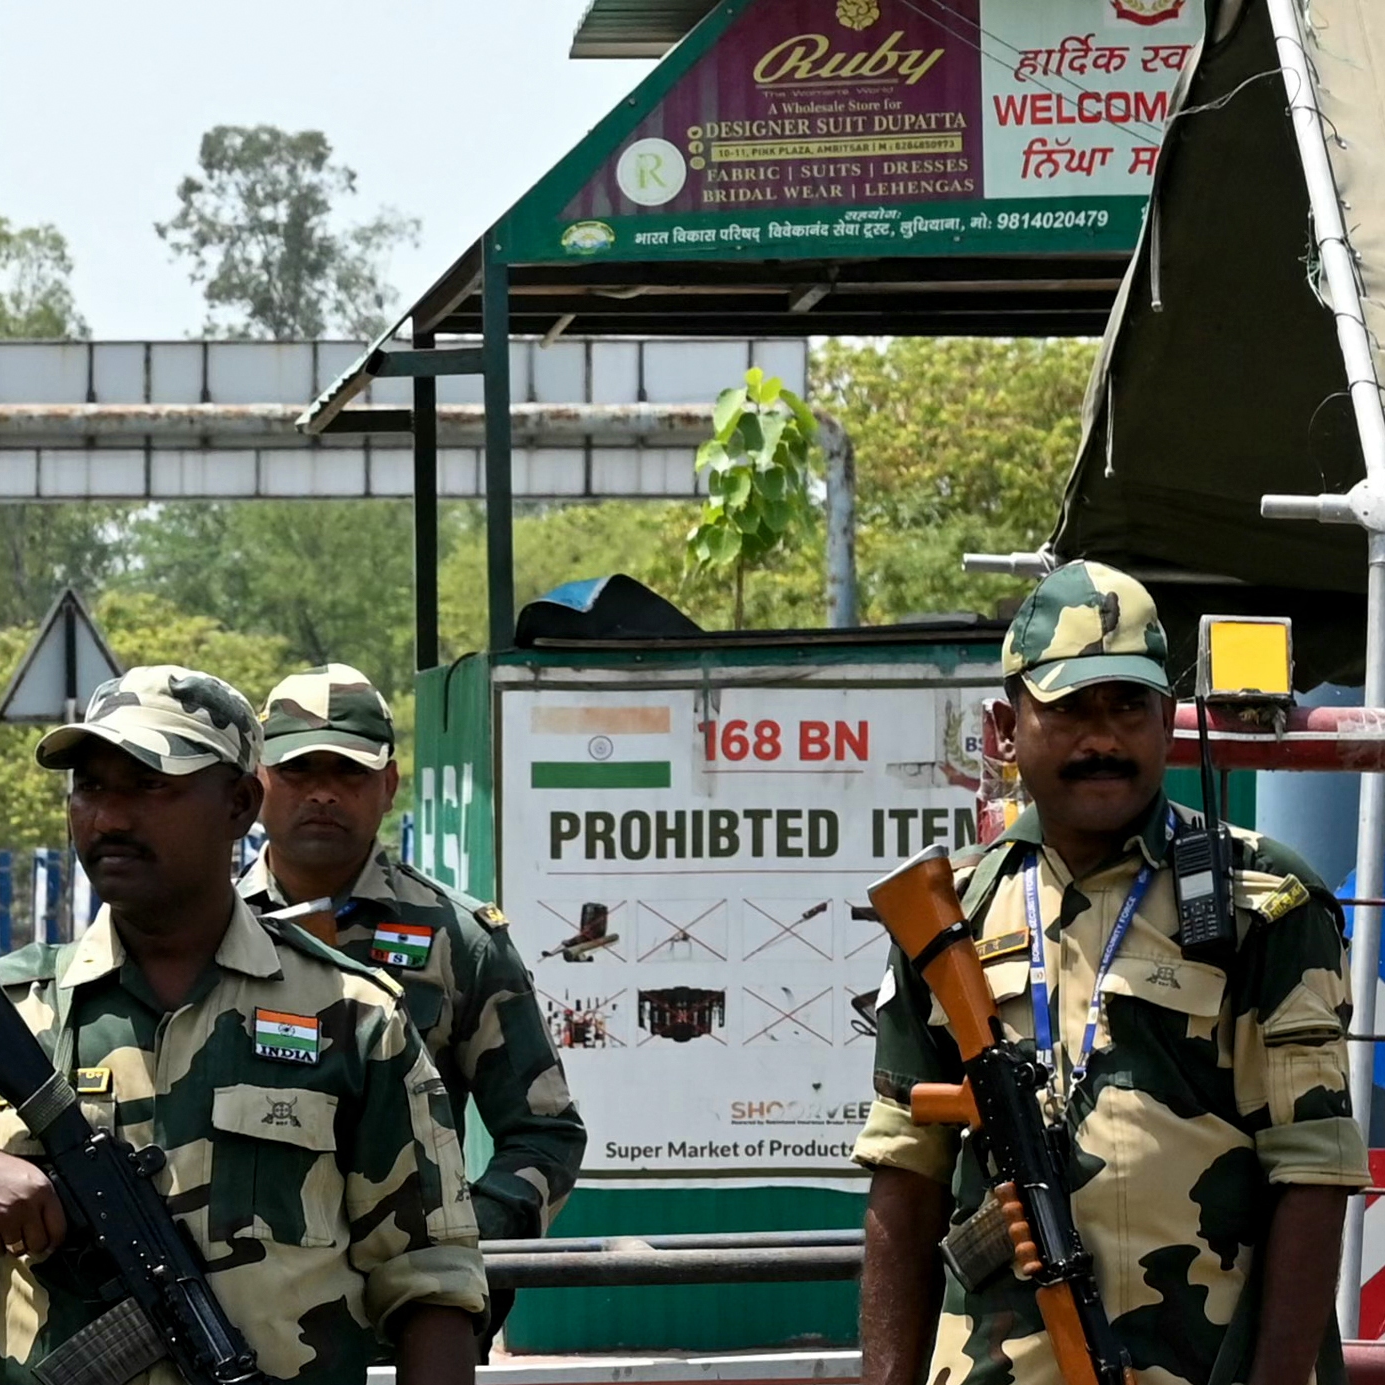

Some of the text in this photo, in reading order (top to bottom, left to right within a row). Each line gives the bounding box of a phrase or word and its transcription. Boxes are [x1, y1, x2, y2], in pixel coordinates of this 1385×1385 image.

[753, 30, 945, 85] Ruby
[1014, 33, 1129, 82] हार्दिक
[768, 98, 902, 115] A Wholesale Store for
[993, 91, 1167, 126] WELCOM
[705, 112, 968, 139] DESIGNER SUIT DUPATTA
[752, 146, 777, 157] PINK
[707, 165, 780, 183] FABRIC
[801, 162, 861, 178] SUITS
[883, 158, 969, 175] DRESSES
[702, 187, 778, 203] BRIDAL
[783, 183, 843, 200] WEAR
[865, 179, 975, 197] LEHENGAS
[635, 231, 669, 246] भारत
[673, 226, 716, 244] विकास
[768, 220, 829, 240] विवेकानंद
[833, 218, 860, 238] सेवा
[997, 210, 1109, 231] 9814020479
[698, 719, 870, 762] 168 BN
[549, 808, 840, 861] PROHIBTED
[261, 1045, 314, 1062] INDIA
[606, 1140, 662, 1162] Super
[667, 1140, 740, 1158] Market
[744, 1139, 765, 1157] of
